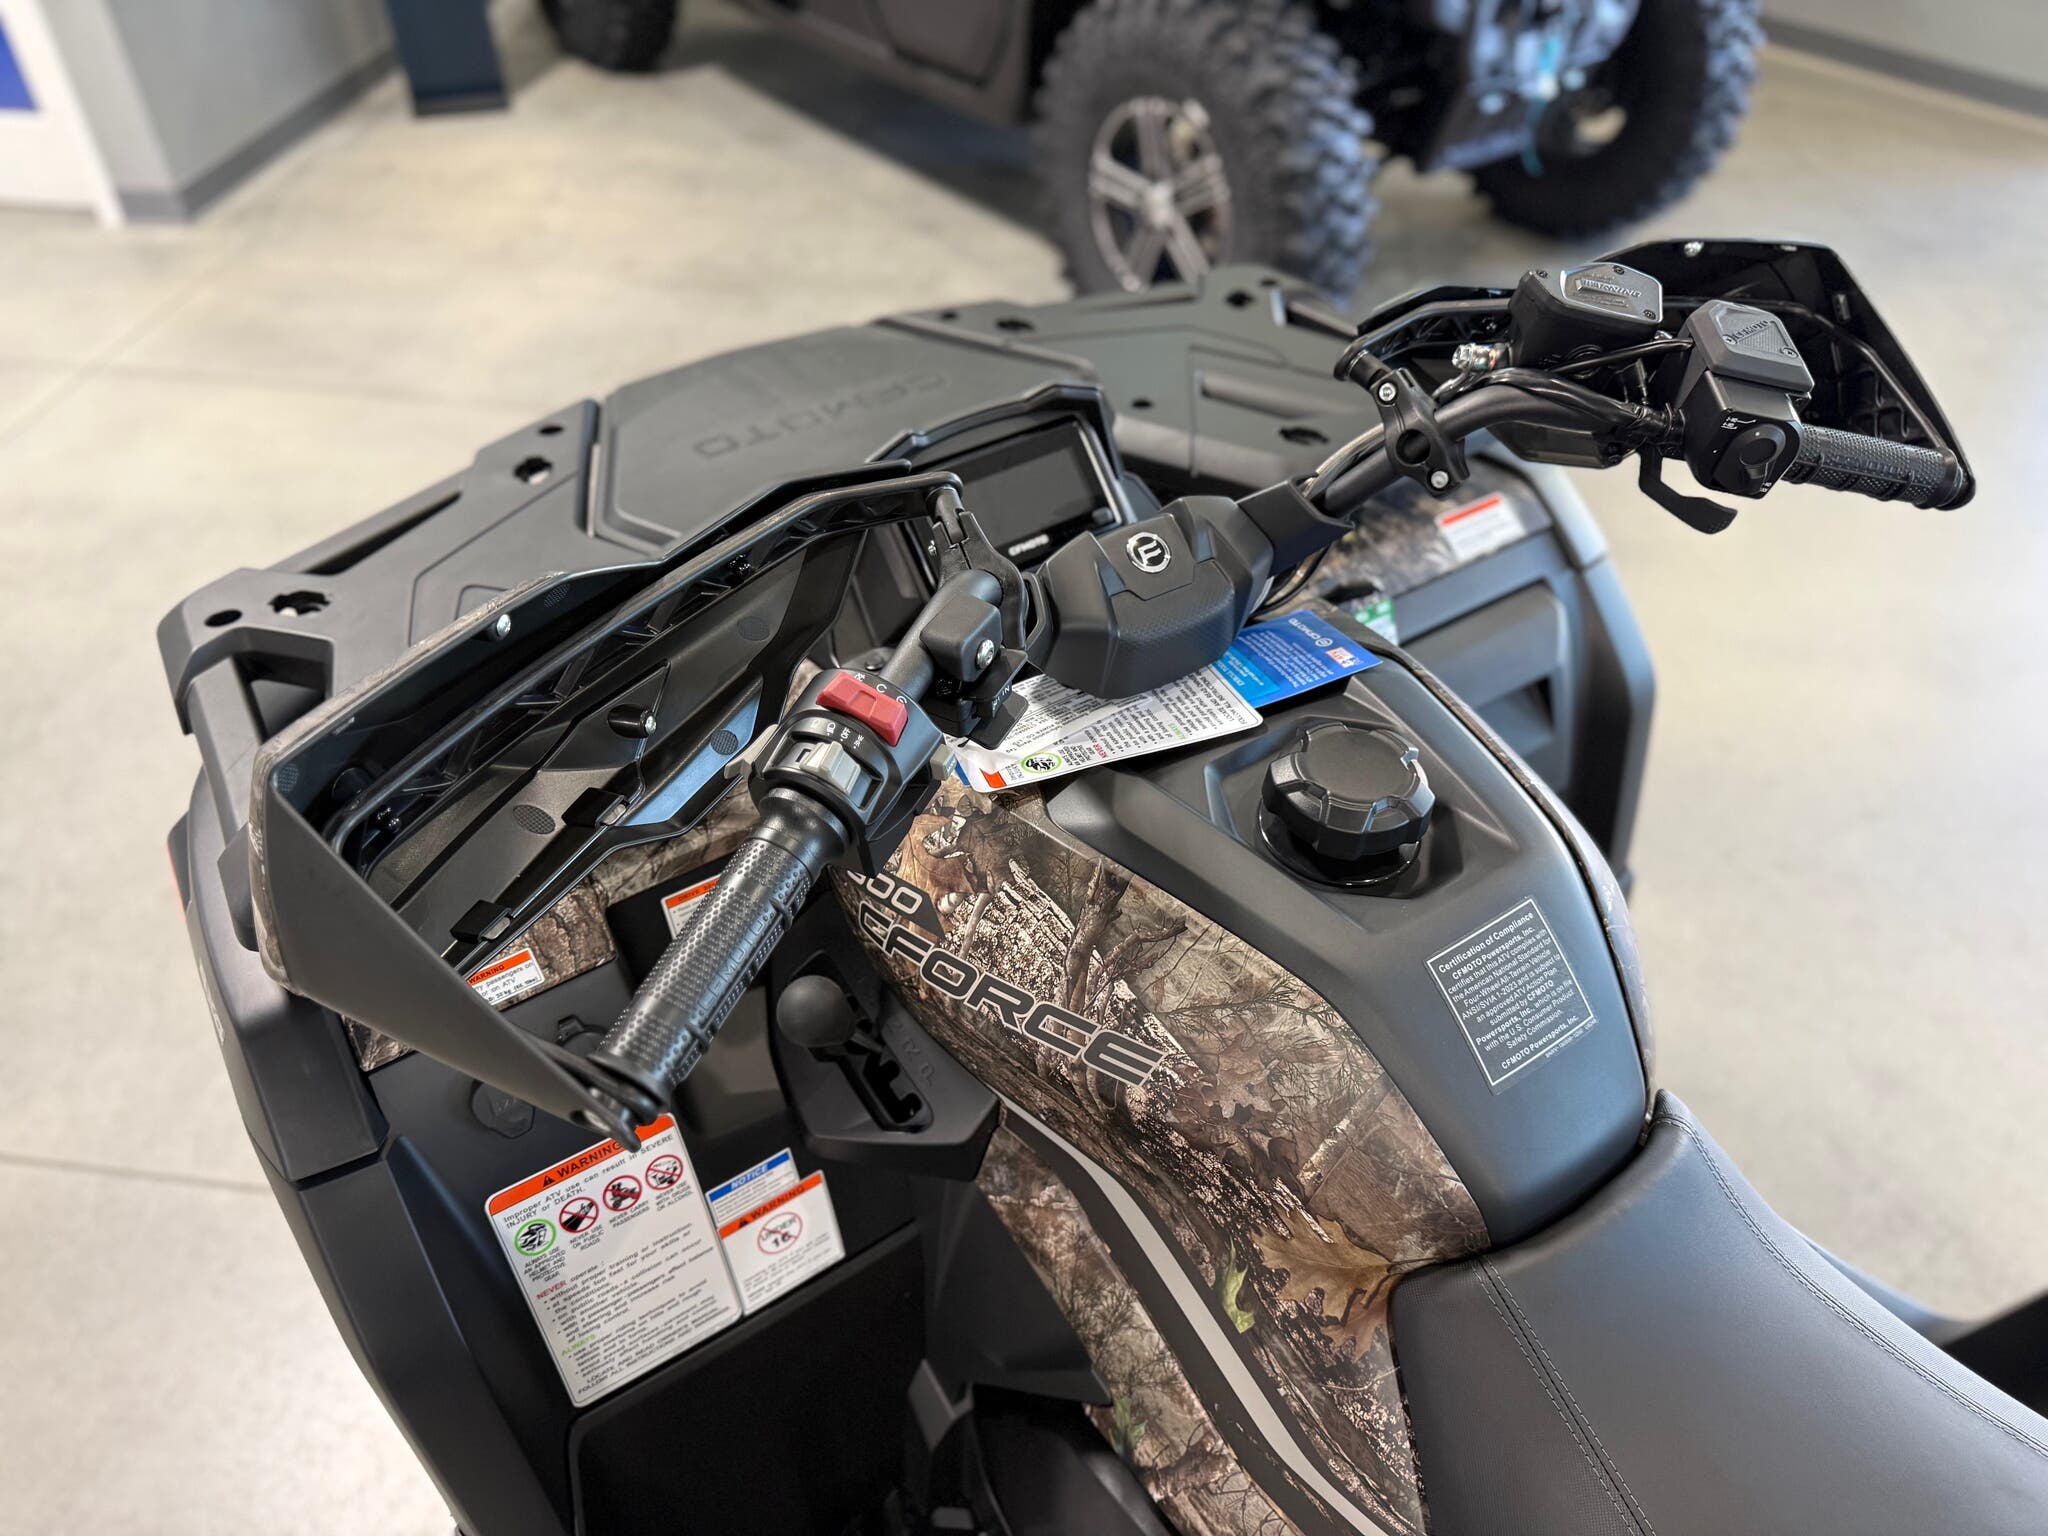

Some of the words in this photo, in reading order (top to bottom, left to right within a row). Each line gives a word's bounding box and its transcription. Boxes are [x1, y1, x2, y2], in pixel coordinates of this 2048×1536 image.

[1437, 939, 1486, 974] Certification
[1483, 934, 1493, 945] of
[1492, 910, 1534, 942] Compliance
[1447, 974, 1474, 995] certifies
[1472, 966, 1487, 979] that
[1485, 959, 1498, 971] this
[1496, 950, 1511, 964] ATV
[1509, 935, 1536, 957] complies
[1534, 928, 1547, 940] with
[1451, 957, 1482, 980] CFMOTO
[1481, 931, 1524, 963] Powersports,
[1521, 924, 1535, 937] Inc.
[468, 964, 505, 983] WARNING
[501, 976, 516, 987] ATV
[858, 900, 1168, 1087] CFORCE
[1451, 991, 1465, 1003] the
[1462, 973, 1493, 996] American
[1492, 957, 1518, 978] National
[1516, 941, 1543, 962] Standard
[1542, 936, 1551, 946] for
[1461, 993, 1497, 1021] ANSI/SVIA
[1495, 980, 1518, 998] 1-2023
[1516, 973, 1529, 985] and
[1527, 969, 1535, 978] is
[1533, 956, 1555, 975] subject
[1553, 952, 1561, 961] to
[1463, 978, 1502, 1008] Four-Wheel
[1499, 960, 1531, 985] All-Terrain
[1528, 947, 1551, 966] Vehicle
[1475, 1013, 1486, 1023] an
[1484, 994, 1515, 1019] approved
[1512, 986, 1526, 999] ATV
[1524, 974, 1544, 991] Action
[1475, 1012, 1521, 1047] Powersports,
[1533, 992, 1552, 1008] which
[1550, 988, 1556, 997] is
[1555, 984, 1564, 993] on
[1484, 1038, 1499, 1052] with
[1497, 1031, 1509, 1043] the
[1522, 1002, 1553, 1027] Consumer
[1551, 987, 1574, 1007] Product
[1488, 1001, 1520, 1026] submitted
[1518, 996, 1528, 1008] by
[1526, 978, 1554, 1002] CFMOTO
[1501, 1046, 1530, 1070] CFMOTO
[1529, 1020, 1568, 1052] Powersports,
[1566, 1013, 1579, 1025] Inc.
[1506, 1031, 1528, 1050] Safety
[503, 1199, 542, 1224] Improper
[544, 1189, 561, 1202] ATV
[565, 1181, 580, 1192] use
[583, 1171, 598, 1183] can
[601, 1157, 626, 1174] result
[628, 1151, 637, 1160] in
[640, 1133, 673, 1154] SEVERE
[556, 1139, 621, 1178] WARNING
[729, 1163, 769, 1190] NOTICE
[506, 1208, 538, 1229] INJURY
[540, 1203, 551, 1211] or
[553, 1184, 586, 1205] DEATH.
[750, 1183, 805, 1220] WARNING
[535, 1278, 568, 1300] NEVER
[568, 1263, 598, 1283] operate
[548, 1282, 578, 1301] without
